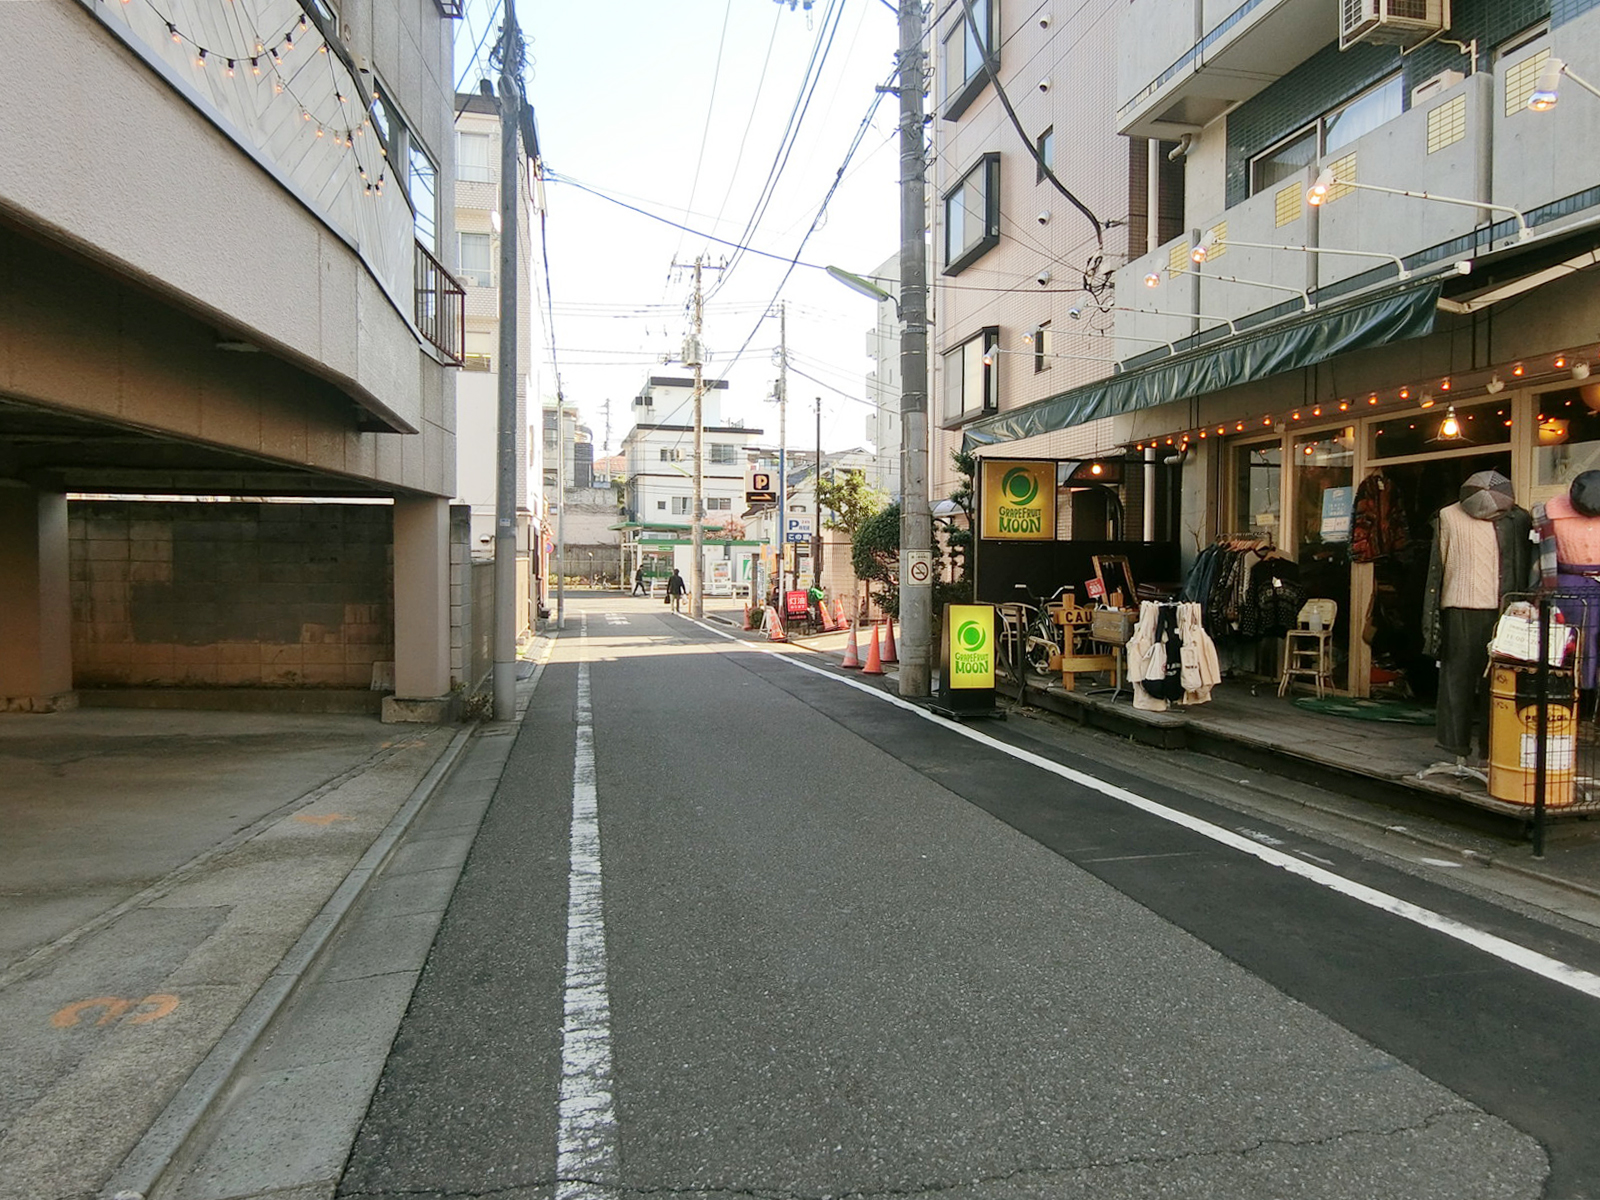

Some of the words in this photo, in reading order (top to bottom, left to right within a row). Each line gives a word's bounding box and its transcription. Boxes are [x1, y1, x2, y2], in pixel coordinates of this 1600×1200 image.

[755, 475, 768, 489] P
[789, 520, 799, 530] P
[999, 517, 1041, 533] MOON
[955, 661, 989, 673] MOON
[50, 994, 180, 1029] 3
